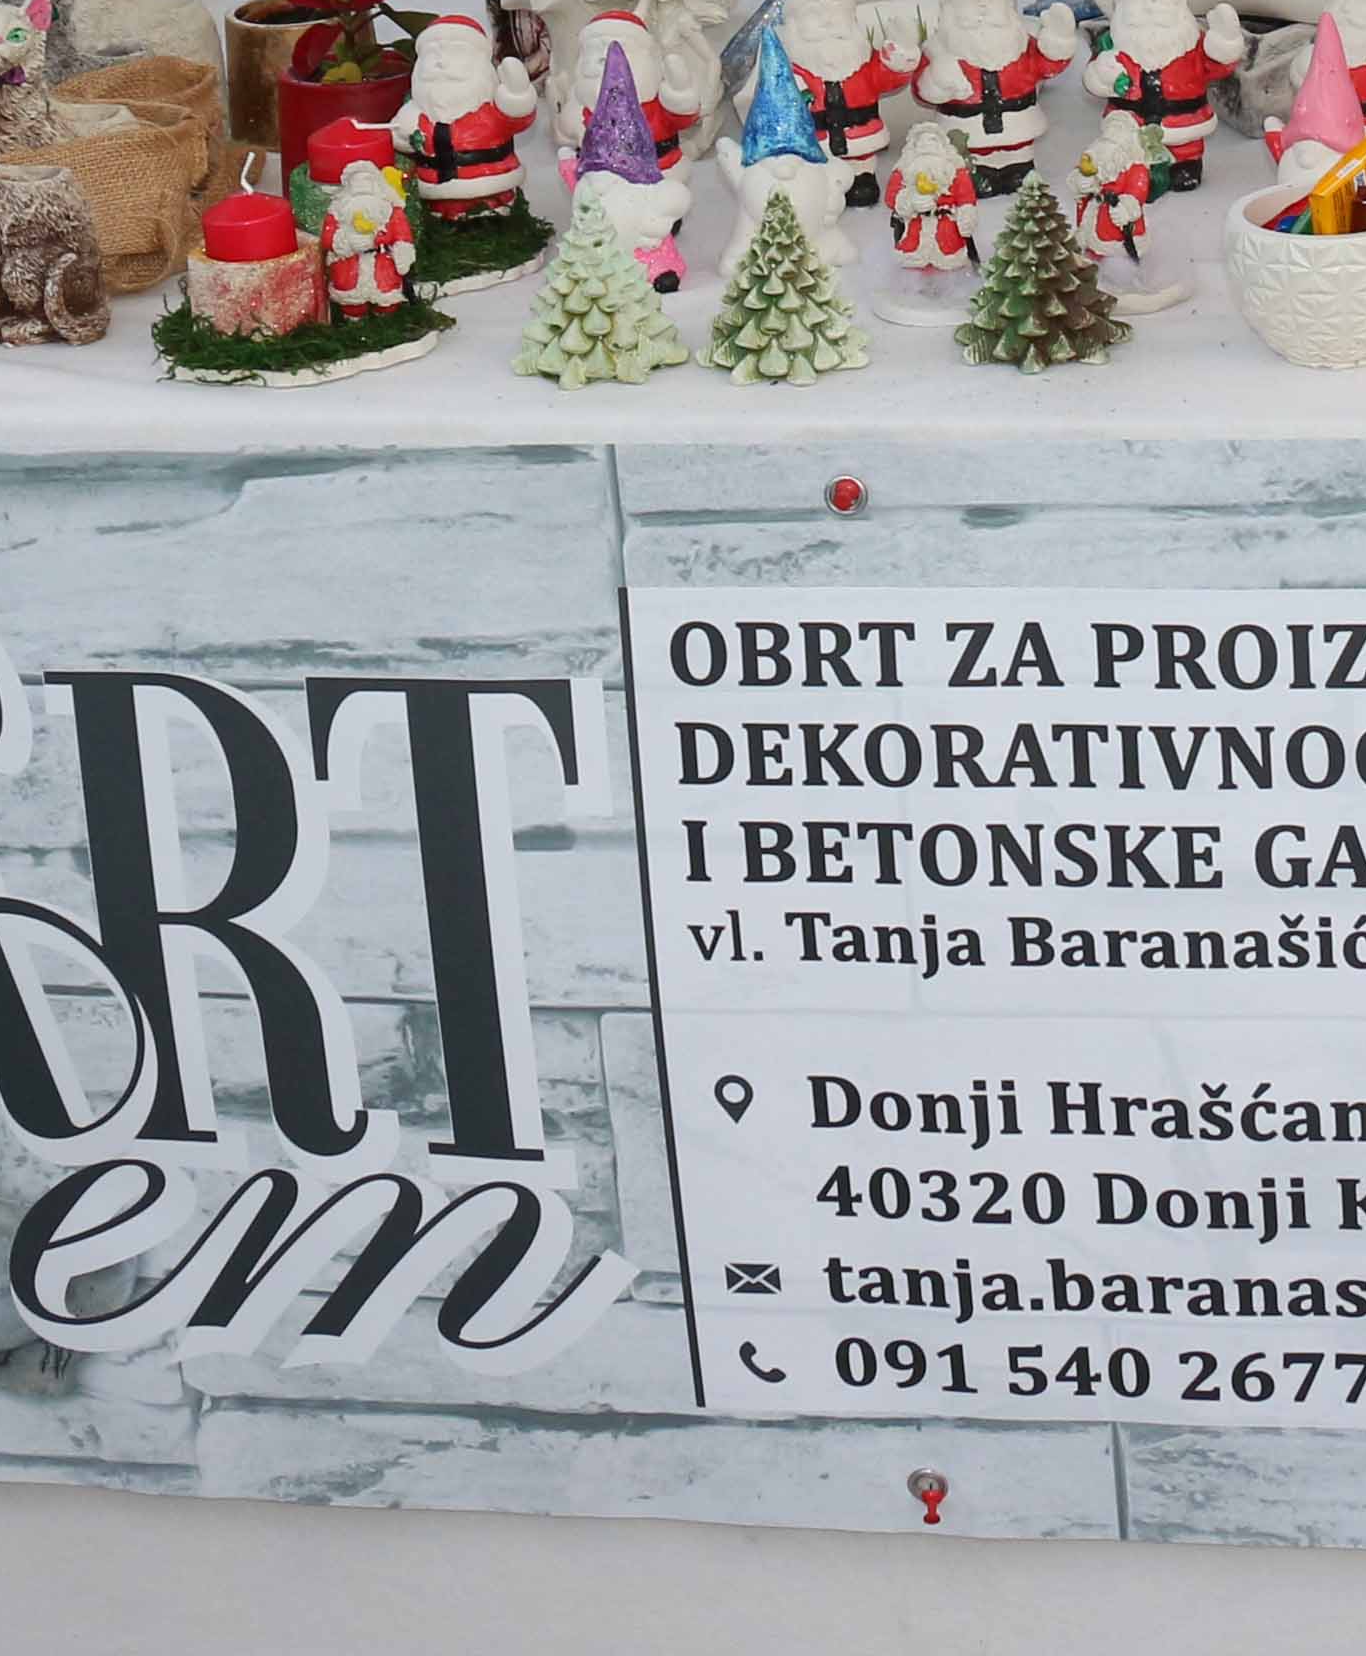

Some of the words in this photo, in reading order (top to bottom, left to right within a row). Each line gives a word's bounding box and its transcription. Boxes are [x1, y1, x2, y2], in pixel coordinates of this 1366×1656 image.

[671, 622, 914, 687] OBRT
[947, 622, 1064, 687] ZA
[683, 821, 711, 882] I
[740, 822, 1222, 889] BETONSKE
[687, 910, 763, 961] vl.
[785, 912, 984, 980] Tanja
[808, 1076, 1021, 1150] Donji
[817, 1165, 1064, 1225] 40320
[1094, 1172, 1310, 1245] Donji
[836, 1337, 977, 1394] 091
[1009, 1344, 1150, 1398] 540
